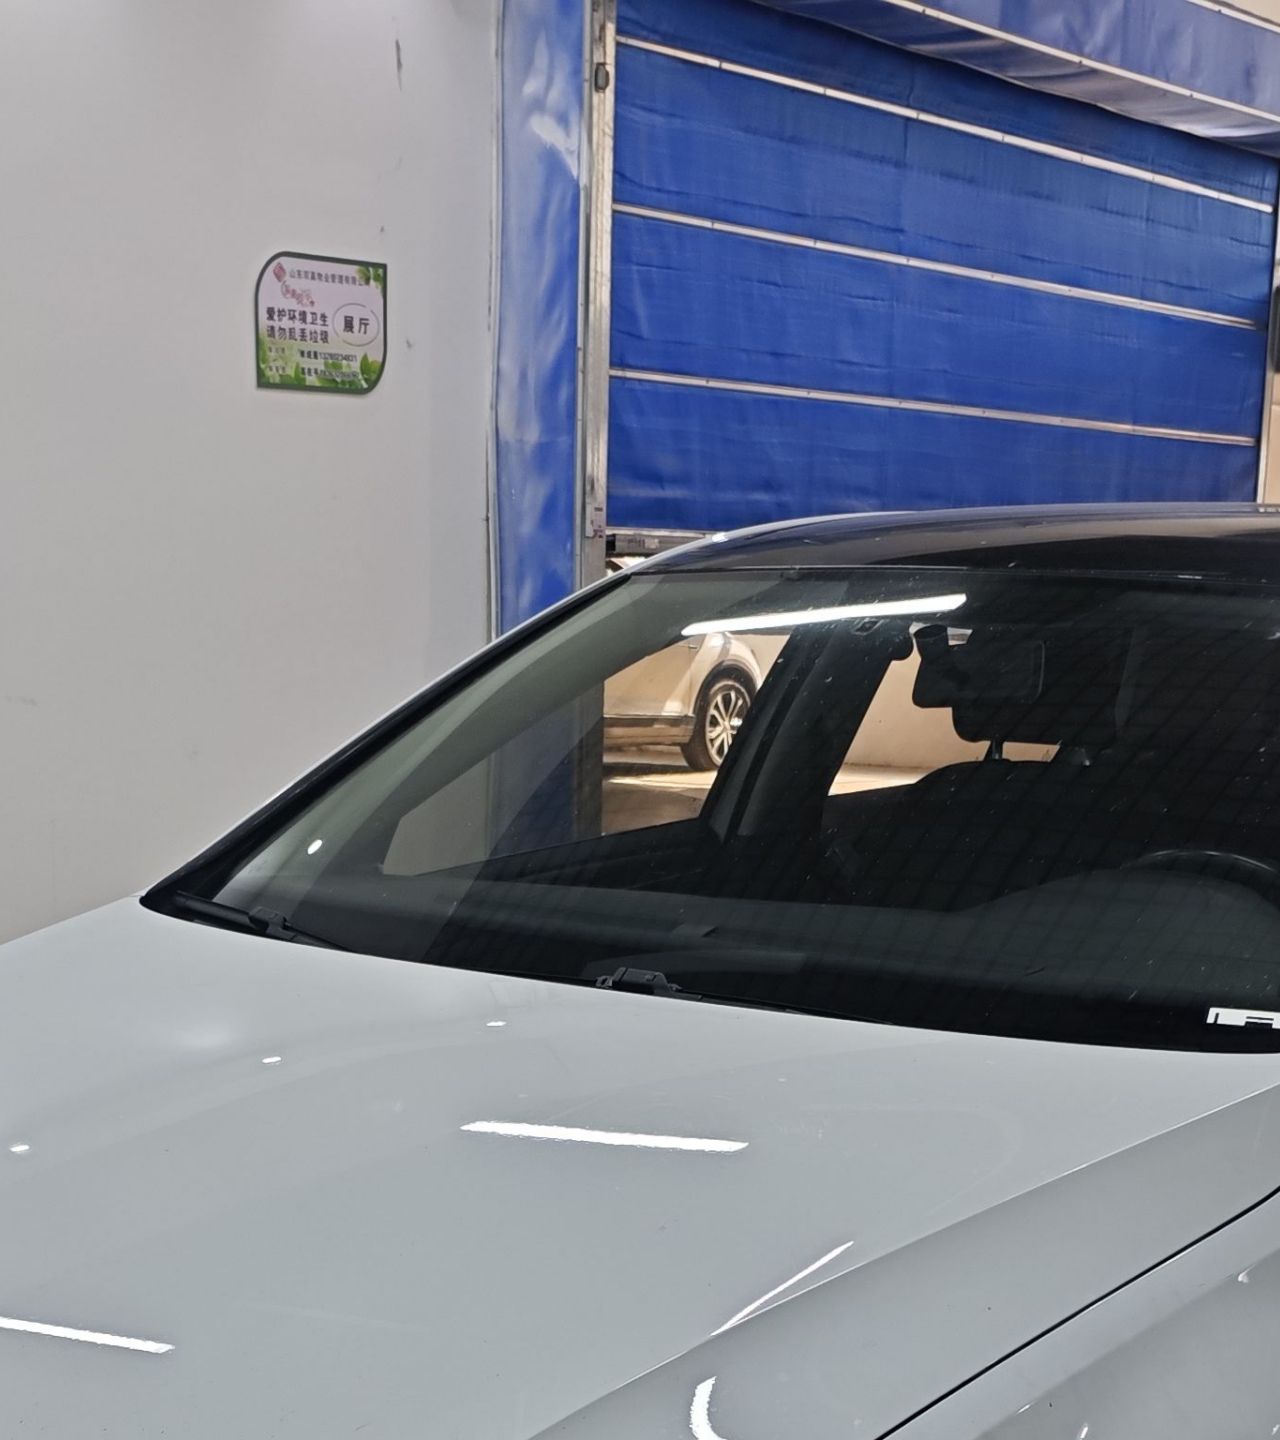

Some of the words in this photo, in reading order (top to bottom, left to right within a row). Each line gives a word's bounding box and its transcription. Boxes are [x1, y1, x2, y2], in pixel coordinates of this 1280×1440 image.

[266, 306, 329, 328] 爱护环境卫生
[343, 315, 370, 335] 展厅
[266, 325, 330, 345] 请勿乱丢垃圾
